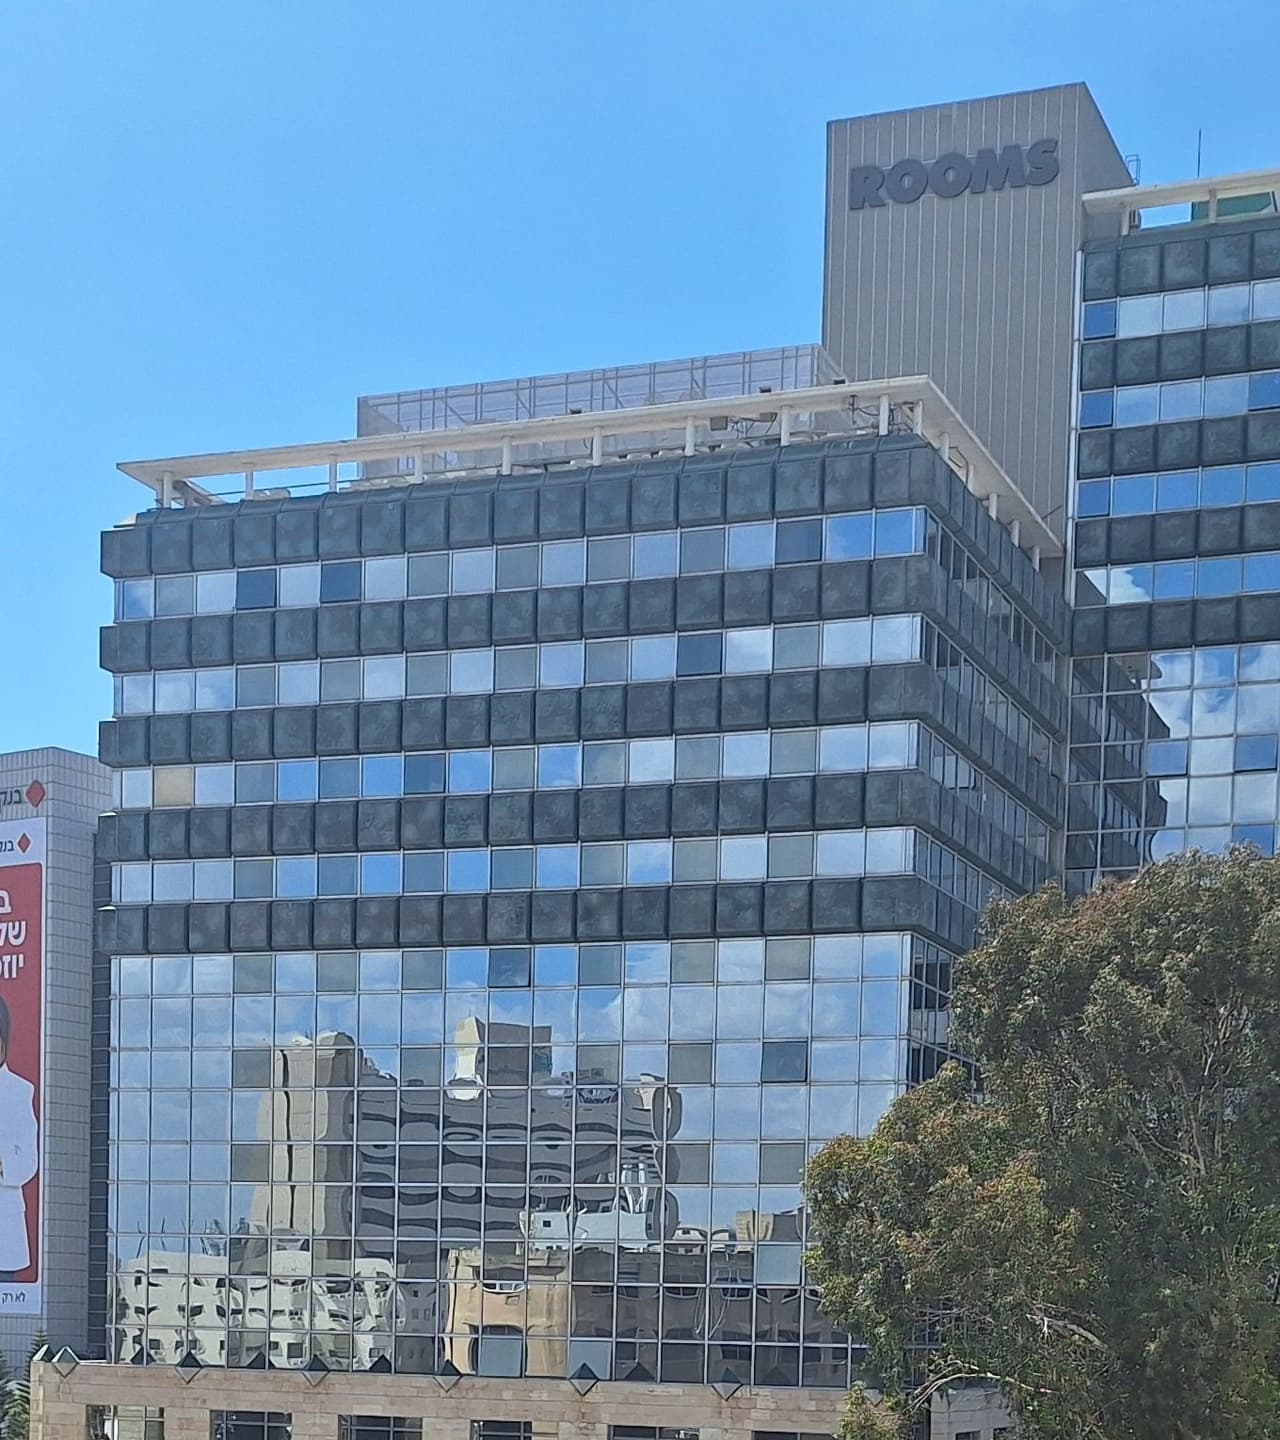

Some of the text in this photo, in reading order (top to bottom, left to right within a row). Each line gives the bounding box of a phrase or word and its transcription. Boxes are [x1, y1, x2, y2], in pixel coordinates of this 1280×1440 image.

[849, 138, 1059, 210] ROOMS
[2, 1292, 14, 1304] רק
[15, 1290, 26, 1303] לא
